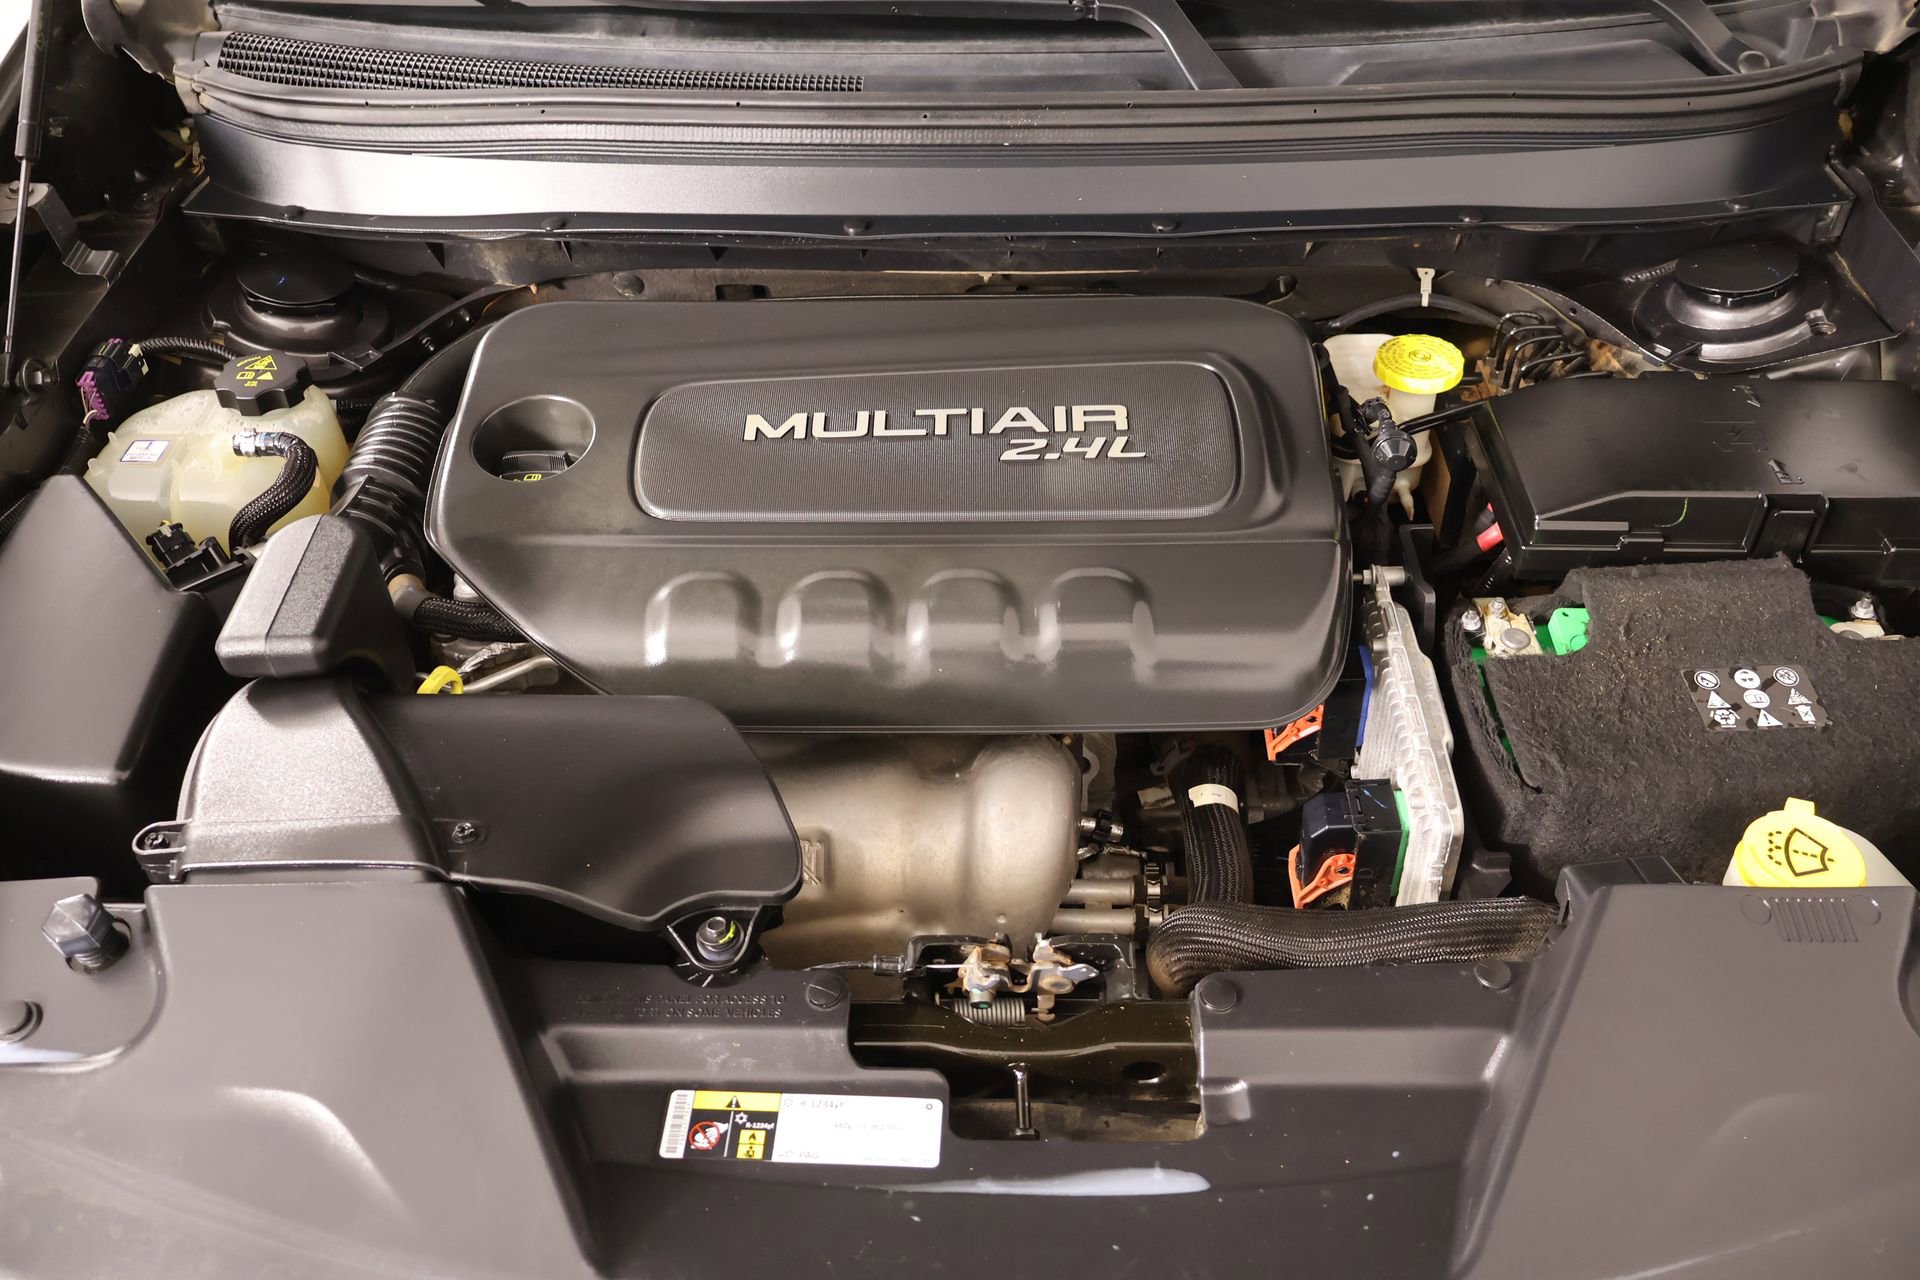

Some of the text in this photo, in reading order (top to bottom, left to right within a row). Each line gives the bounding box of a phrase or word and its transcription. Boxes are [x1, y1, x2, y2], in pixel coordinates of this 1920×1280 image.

[743, 404, 1129, 440] MULTIAIR
[999, 436, 1147, 461] 2.4L
[696, 994, 720, 1005] FOR
[722, 994, 767, 1005] ACCESS
[770, 994, 786, 1005] TO
[666, 1008, 683, 1018] ON
[687, 1008, 720, 1018] SOME
[727, 1008, 782, 1018] VEHICLES
